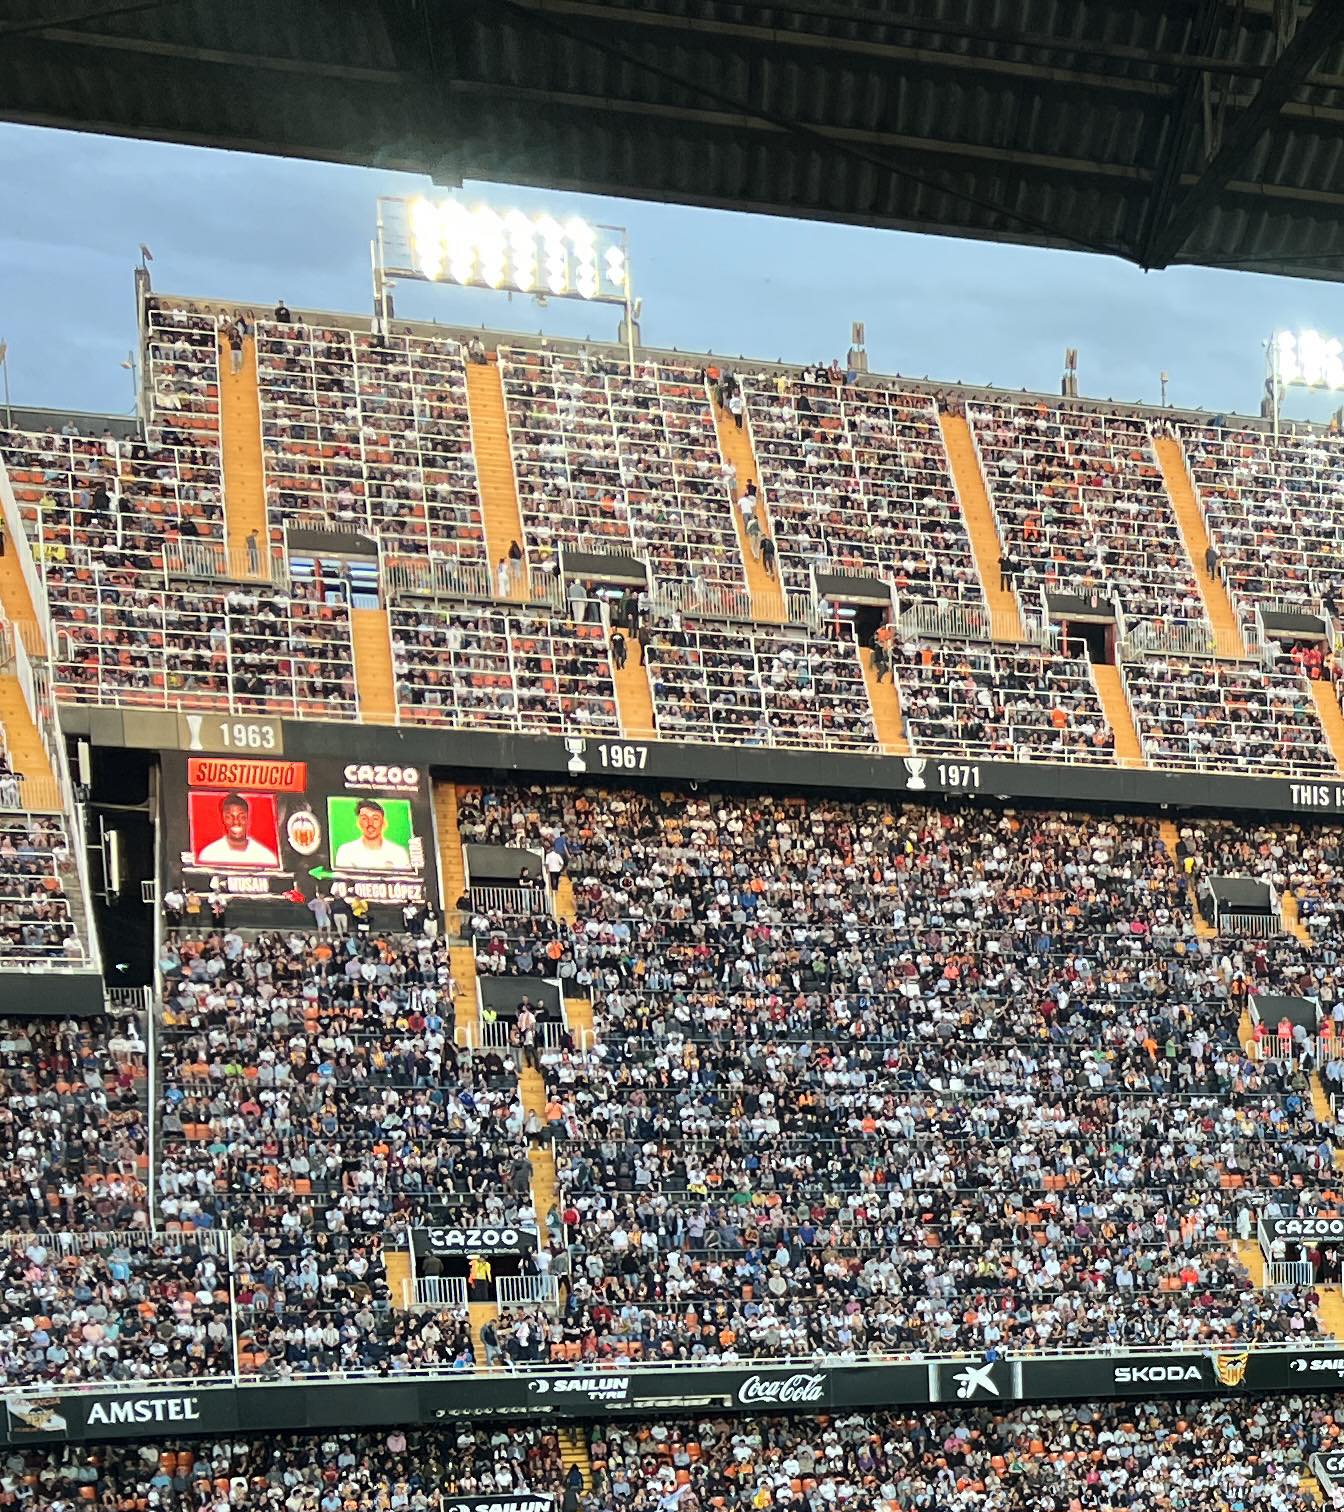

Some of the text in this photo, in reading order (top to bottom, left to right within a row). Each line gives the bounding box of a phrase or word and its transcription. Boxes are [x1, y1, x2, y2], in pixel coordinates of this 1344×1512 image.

[220, 723, 275, 749] 1963
[598, 744, 648, 769] 1967
[196, 761, 295, 786] SUBSTITUCIÓ
[343, 764, 419, 784] CAZOO
[937, 764, 980, 788] 1971
[1290, 784, 1330, 807] THIS
[210, 876, 220, 891] 4
[431, 1229, 519, 1246] CAZOO
[1274, 1219, 1343, 1235] CAZOO
[1114, 1365, 1202, 1382] SKODA
[553, 1377, 629, 1393] SAILUN
[587, 1390, 628, 1401] TYRE
[738, 1373, 827, 1403] Coca-Cola
[87, 1398, 200, 1425] AMSTEL
